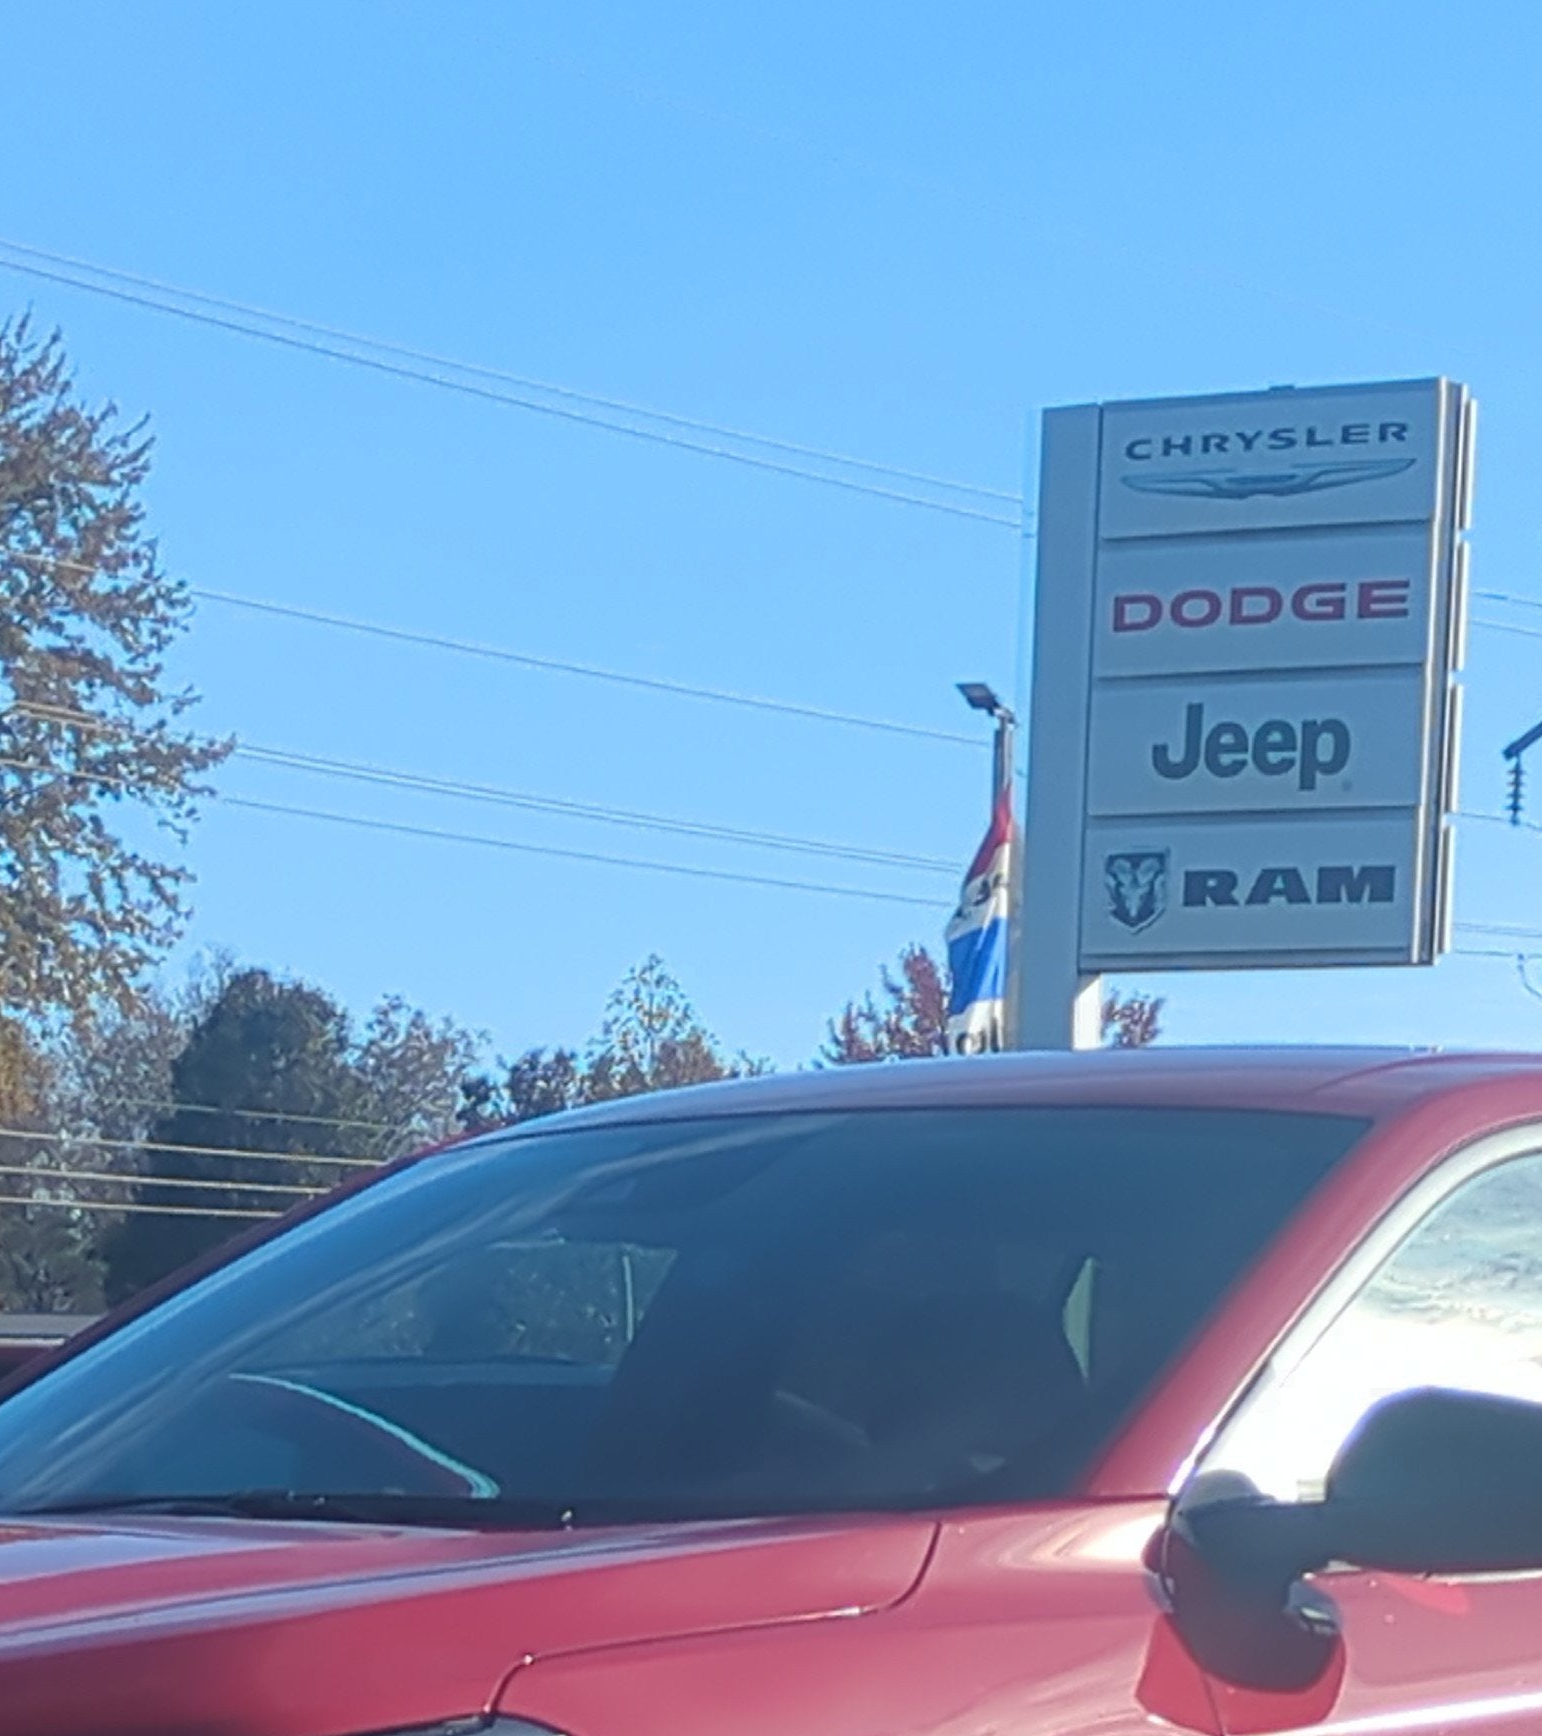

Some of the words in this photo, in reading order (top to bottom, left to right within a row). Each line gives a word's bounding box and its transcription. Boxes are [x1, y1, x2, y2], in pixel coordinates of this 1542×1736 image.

[1124, 421, 1408, 460] CHRYSLER
[1112, 579, 1410, 633] DODGE
[1152, 702, 1351, 791] Jeep
[1182, 866, 1396, 907] RAM
